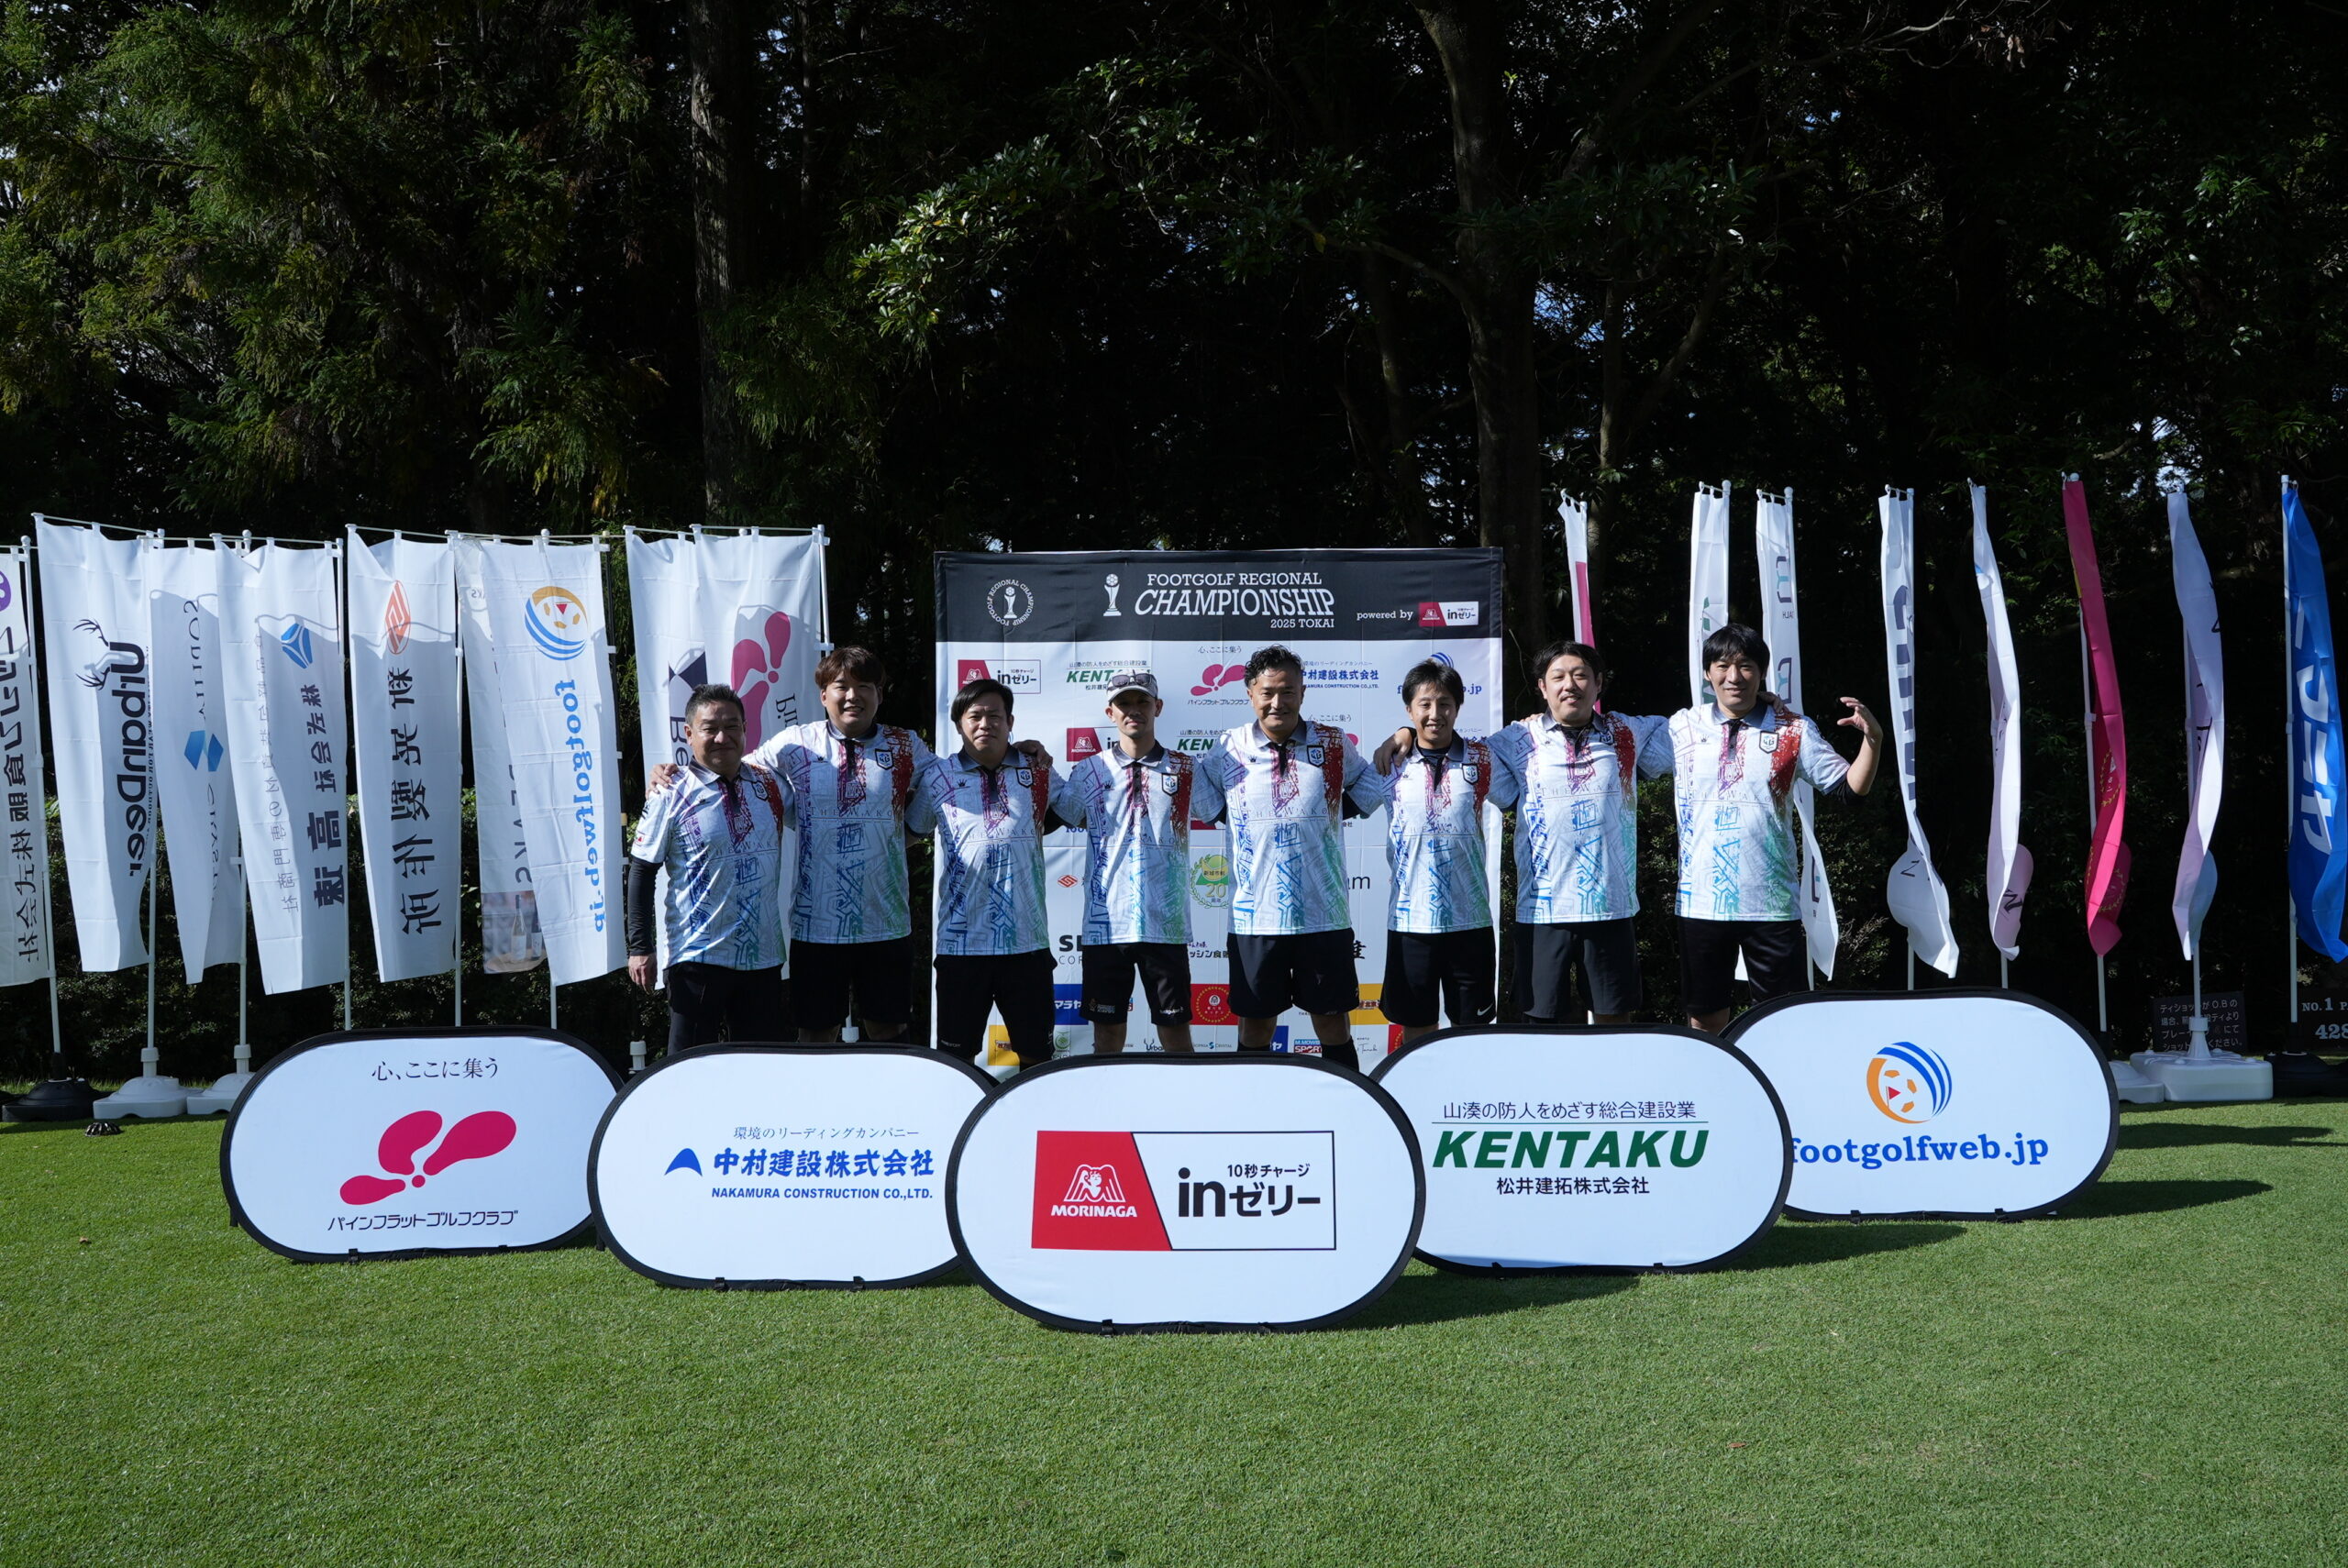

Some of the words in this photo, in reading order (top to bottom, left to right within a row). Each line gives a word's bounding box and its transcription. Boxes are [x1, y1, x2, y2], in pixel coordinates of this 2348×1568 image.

[1147, 573, 1235, 587] FOOTGOLF
[1239, 572, 1322, 585] REGIONAL
[1135, 588, 1335, 617] CHAMPIONSHIP
[1270, 619, 1296, 629] 2025
[1299, 618, 1335, 628] TOKAI
[1357, 611, 1396, 621] powered
[1400, 610, 1413, 620] by
[1198, 646, 1242, 654] 心、ここに集う
[997, 670, 1037, 686] inゼリー
[1205, 883, 1226, 899] 20
[371, 1057, 499, 1081] 心、ここに集う
[1444, 1100, 1697, 1120] 山湊の防人をめざす総合建設業
[733, 1126, 919, 1141] 環境のリーディングカンパニー
[1433, 1130, 1710, 1169] KENTAKU
[714, 1147, 935, 1178] 中村建設株式会社
[1227, 1163, 1311, 1178] 10秒チャージ
[711, 1187, 780, 1198] NAKAMURA
[783, 1187, 880, 1199] CONSTRUCTION
[883, 1187, 934, 1201] CO.,LTD.
[1178, 1167, 1321, 1218] inゼリー
[1496, 1176, 1650, 1196] 松井建拓株式会社
[1051, 1205, 1137, 1218] MORINAGA
[327, 1209, 519, 1232] パインフラットゴルフクラブ
